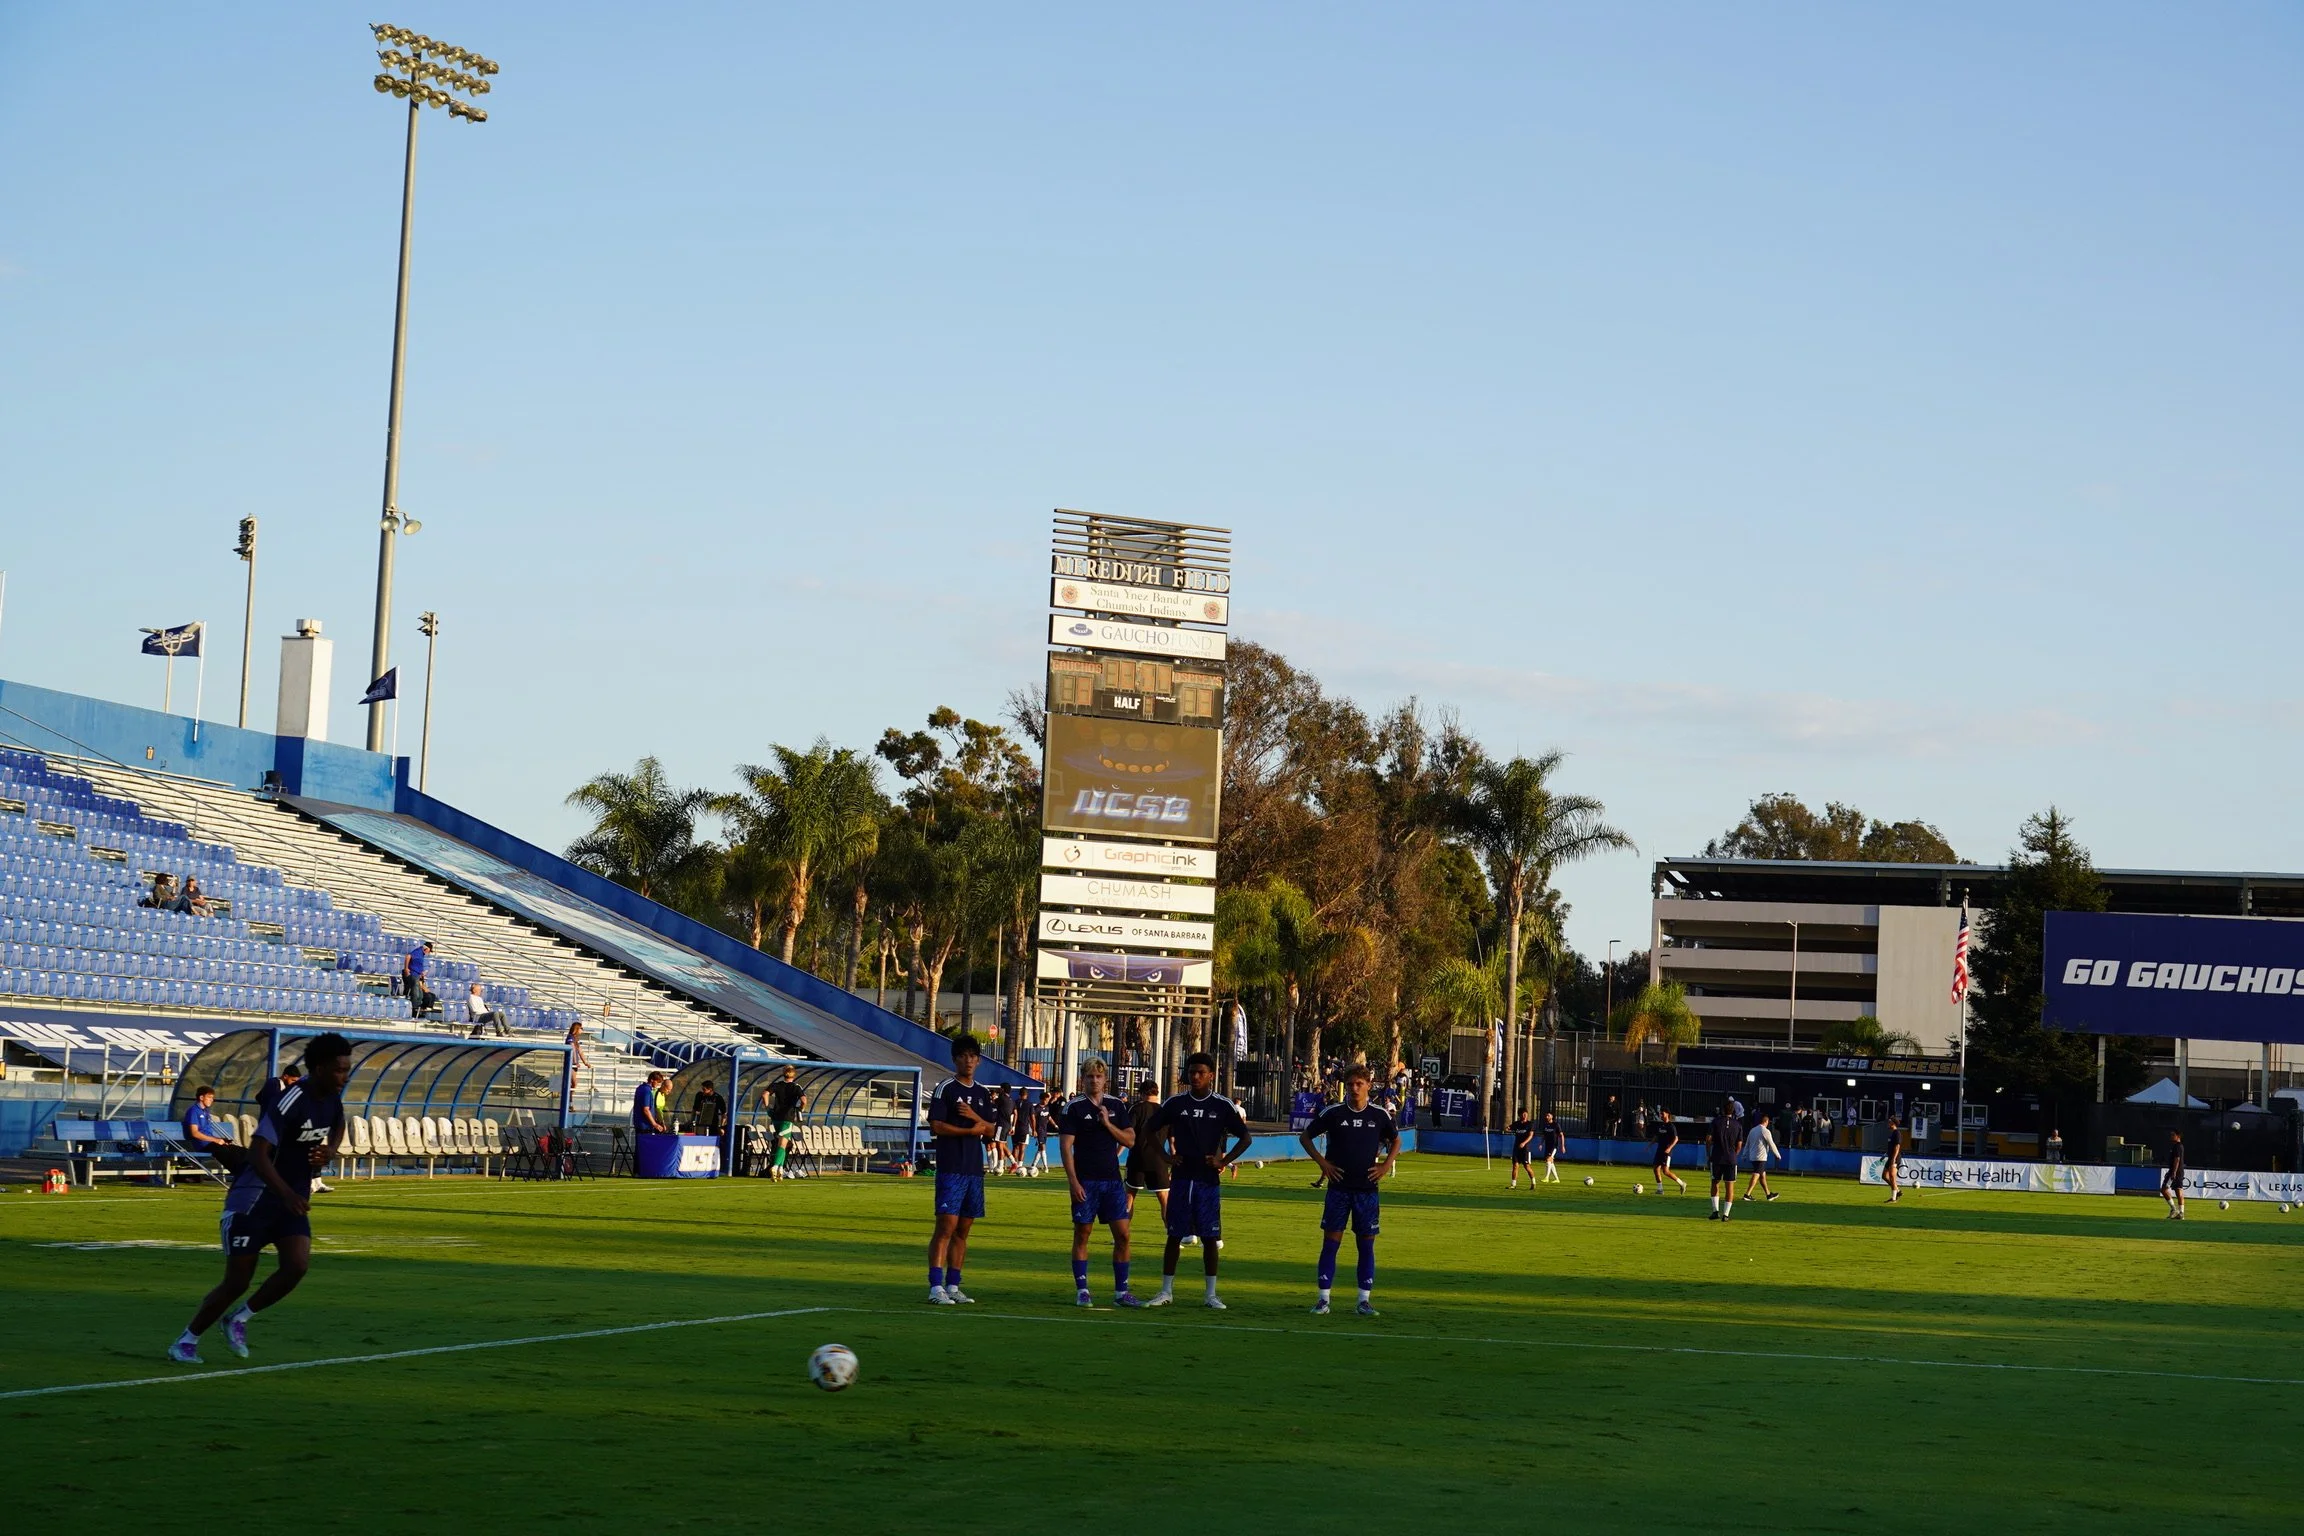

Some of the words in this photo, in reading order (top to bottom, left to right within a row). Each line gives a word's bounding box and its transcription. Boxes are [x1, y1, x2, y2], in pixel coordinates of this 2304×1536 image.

[1053, 555, 1162, 586] MEREDITH
[1172, 567, 1230, 593] FIELD
[1090, 585, 1119, 598] Santa
[1124, 588, 1148, 601] Ynez
[1152, 592, 1179, 605] Band
[1182, 596, 1193, 606] of
[1096, 599, 1145, 613] Chumash
[1149, 603, 1187, 617] Indians
[1113, 696, 1141, 710] HALF
[1073, 788, 1190, 822] UCSB
[1087, 880, 1171, 900] CHUMASH
[1067, 924, 1123, 935] LEXUS
[1131, 928, 1143, 936] OF
[1144, 929, 1169, 938] SANTA
[1170, 930, 1207, 941] BARBARA
[2061, 958, 2121, 986] GO
[0, 1020, 112, 1051] WE
[86, 1026, 202, 1052] ARE
[1422, 1061, 1439, 1076] 50
[1826, 1057, 1869, 1071] UCSB
[966, 1095, 973, 1105] 2
[1192, 1108, 1204, 1118] 31
[1352, 1119, 1363, 1128] 15
[1897, 1164, 1963, 1184] Cottage
[1967, 1166, 2022, 1184] Health
[2193, 1180, 2250, 1190] LEXUS
[2268, 1183, 2303, 1192] LEXUS
[232, 1235, 250, 1248] 27
